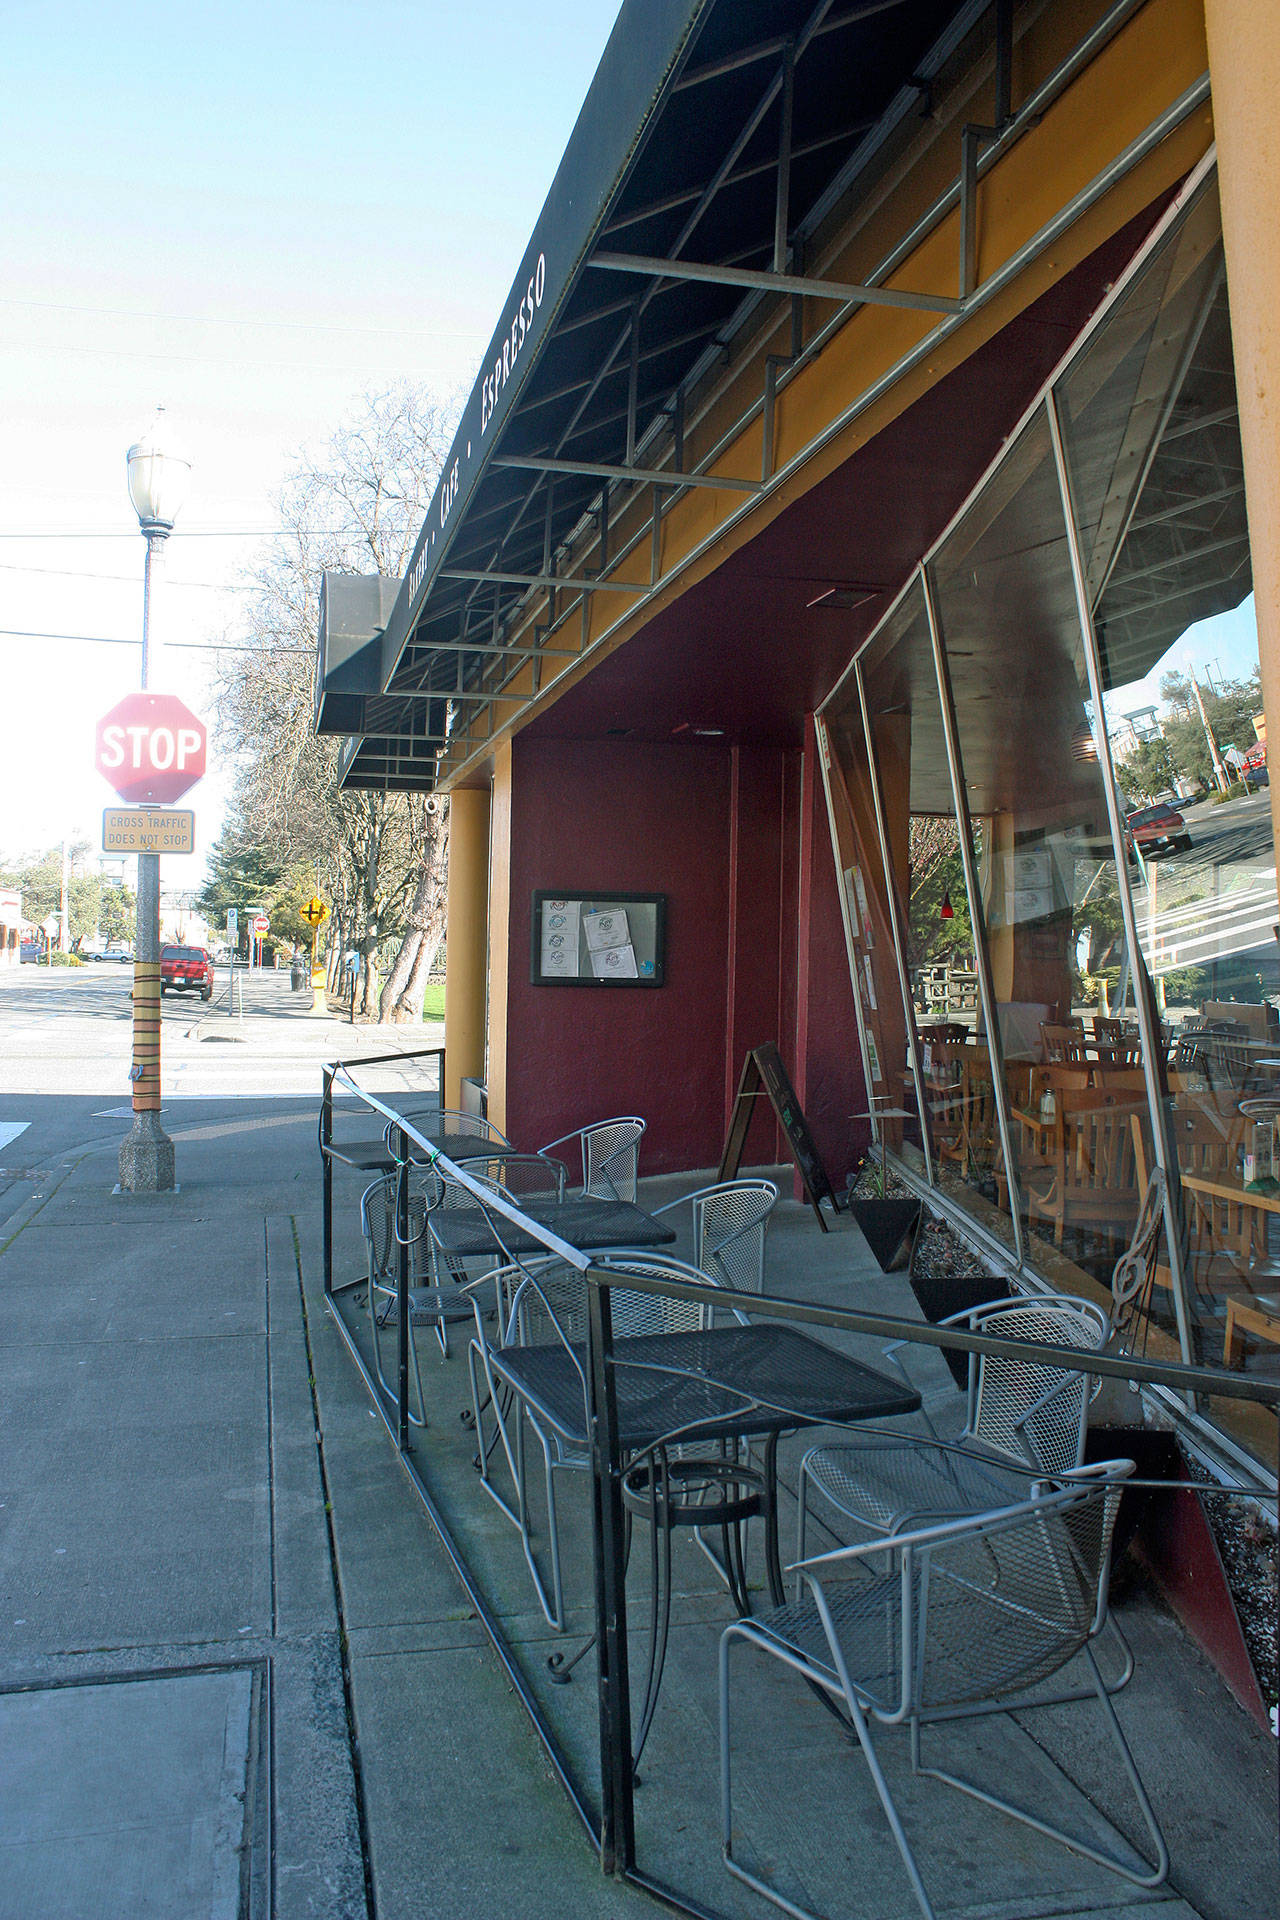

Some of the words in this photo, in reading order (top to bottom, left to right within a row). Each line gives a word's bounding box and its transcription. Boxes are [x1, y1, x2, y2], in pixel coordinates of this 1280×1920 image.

[481, 252, 546, 436] ESPRESSO
[101, 725, 202, 770] STOP
[110, 817, 144, 828] CROSS
[149, 817, 187, 829] TRAFFIC
[109, 833, 135, 844] DOES
[140, 834, 158, 845] NOT
[163, 834, 188, 845] STOP
